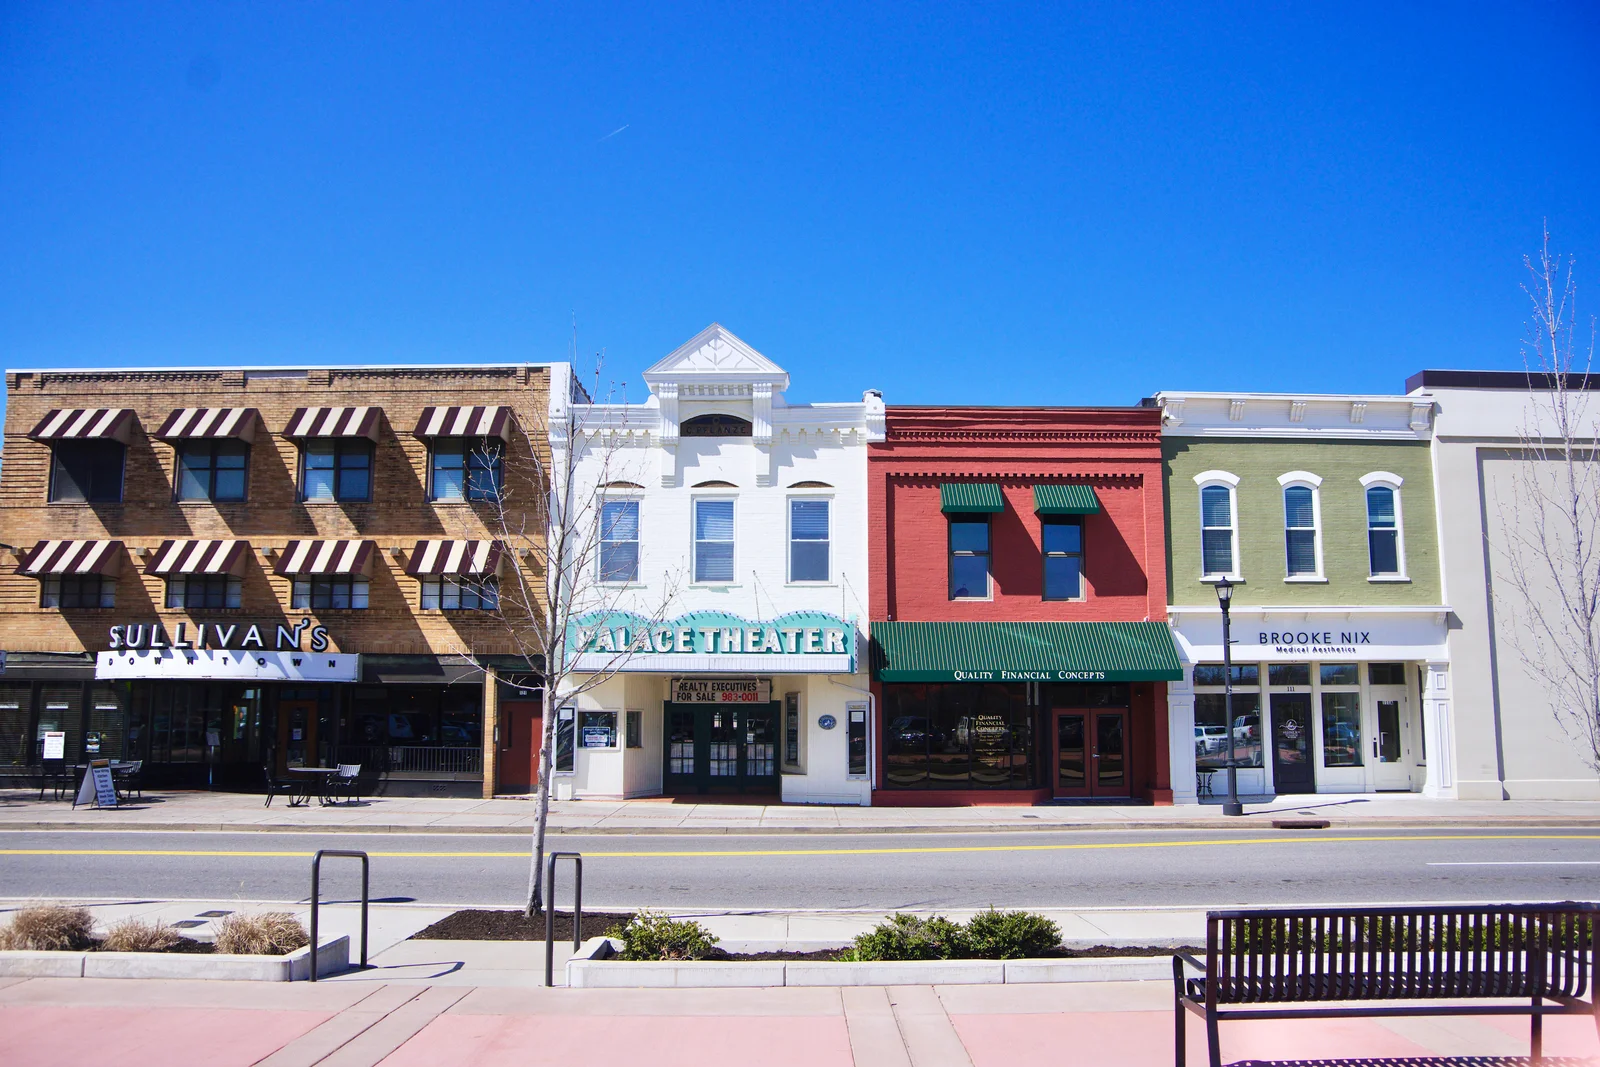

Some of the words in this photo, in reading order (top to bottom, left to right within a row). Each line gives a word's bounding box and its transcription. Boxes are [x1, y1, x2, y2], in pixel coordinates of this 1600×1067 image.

[109, 618, 329, 651] SULLIVAN'S
[575, 626, 694, 653] PALACE
[699, 627, 846, 653] THEATER
[1259, 632, 1332, 644] BROOKE
[1341, 632, 1370, 644] NIX
[108, 657, 336, 668] DOWNTOWN
[679, 682, 708, 691] REALTY
[711, 682, 757, 691] EXECUTIVES
[677, 692, 692, 701] FOR
[696, 692, 715, 701] SALE
